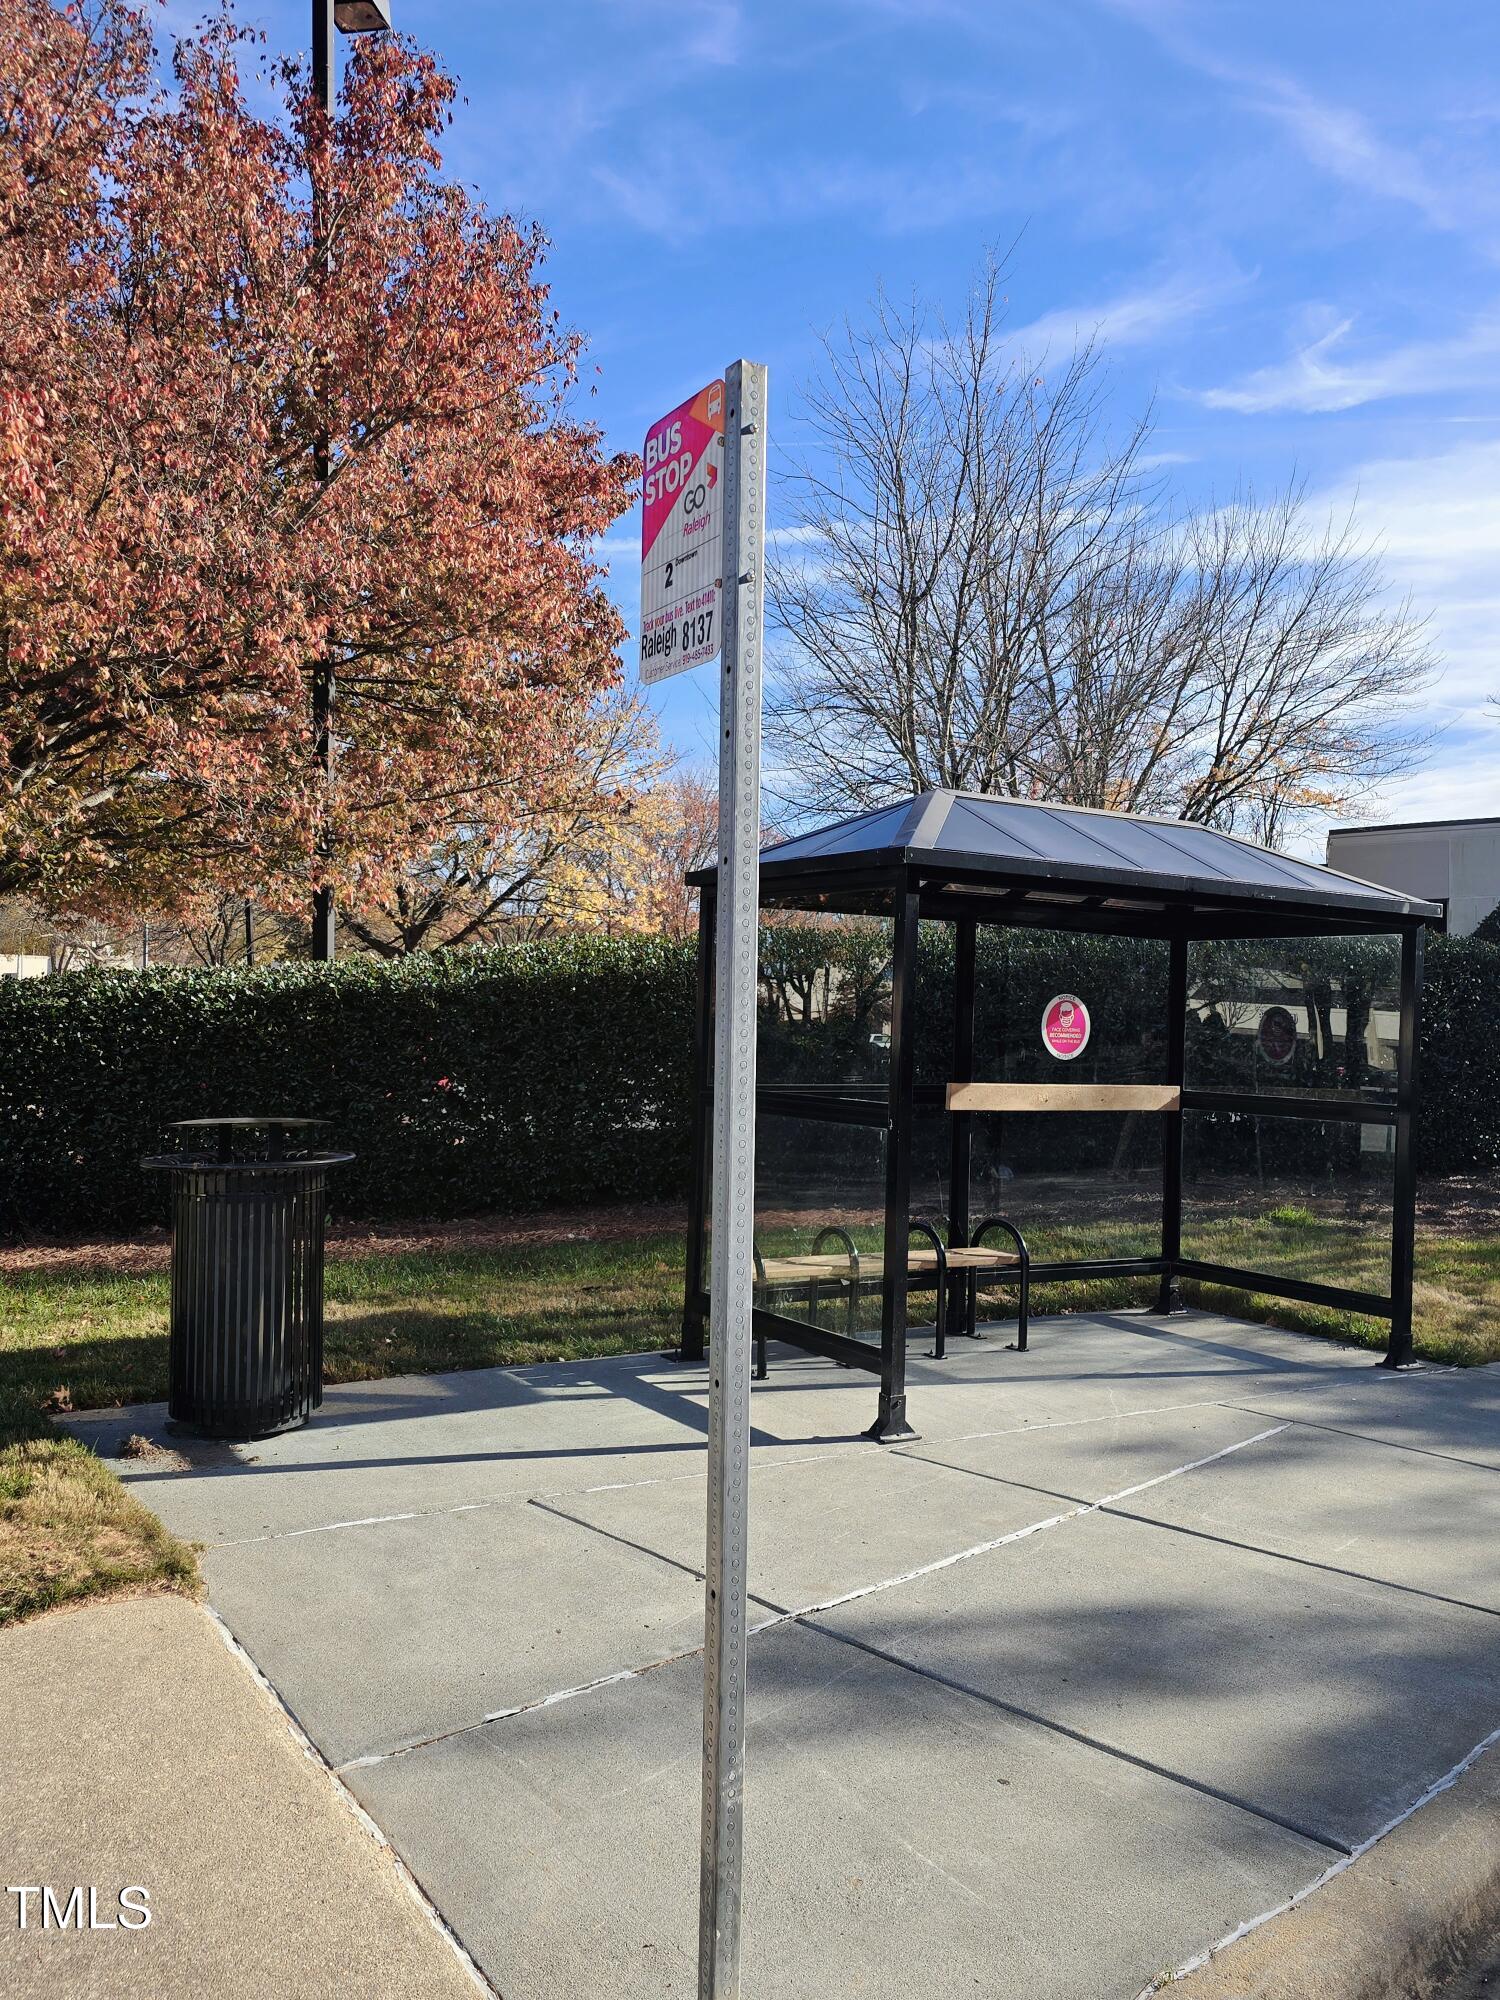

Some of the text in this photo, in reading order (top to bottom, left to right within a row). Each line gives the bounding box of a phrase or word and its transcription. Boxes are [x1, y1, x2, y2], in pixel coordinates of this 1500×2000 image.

[646, 421, 682, 471] BUS
[645, 452, 692, 506] STOP
[684, 484, 706, 514] GO
[683, 510, 711, 537] Raleigh
[665, 563, 673, 589] 2
[685, 600, 695, 614] Text
[641, 610, 713, 660] Raleigh 8137
